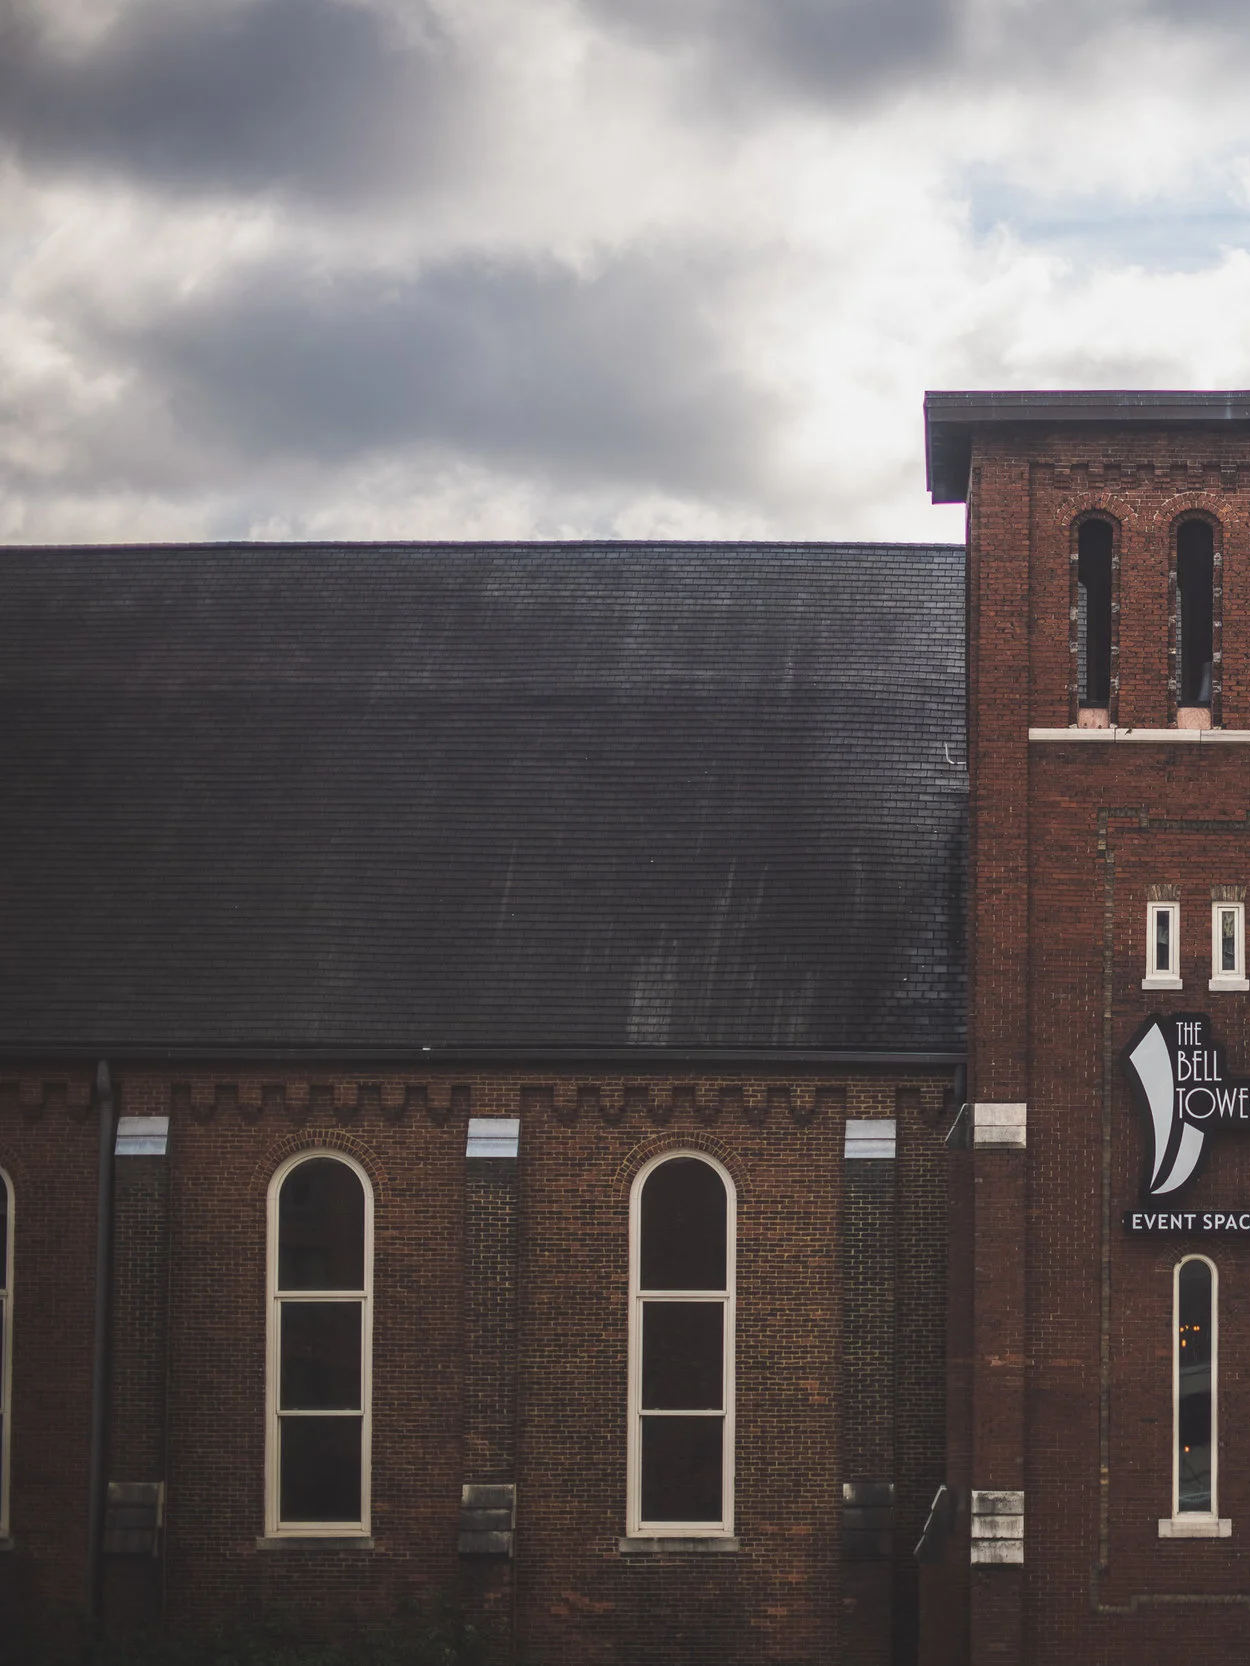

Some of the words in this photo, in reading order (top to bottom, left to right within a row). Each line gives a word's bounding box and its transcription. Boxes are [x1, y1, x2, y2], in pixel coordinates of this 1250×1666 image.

[1175, 1021, 1202, 1046] THE
[1177, 1050, 1222, 1082] BELL
[1132, 1213, 1197, 1230] EVENT
